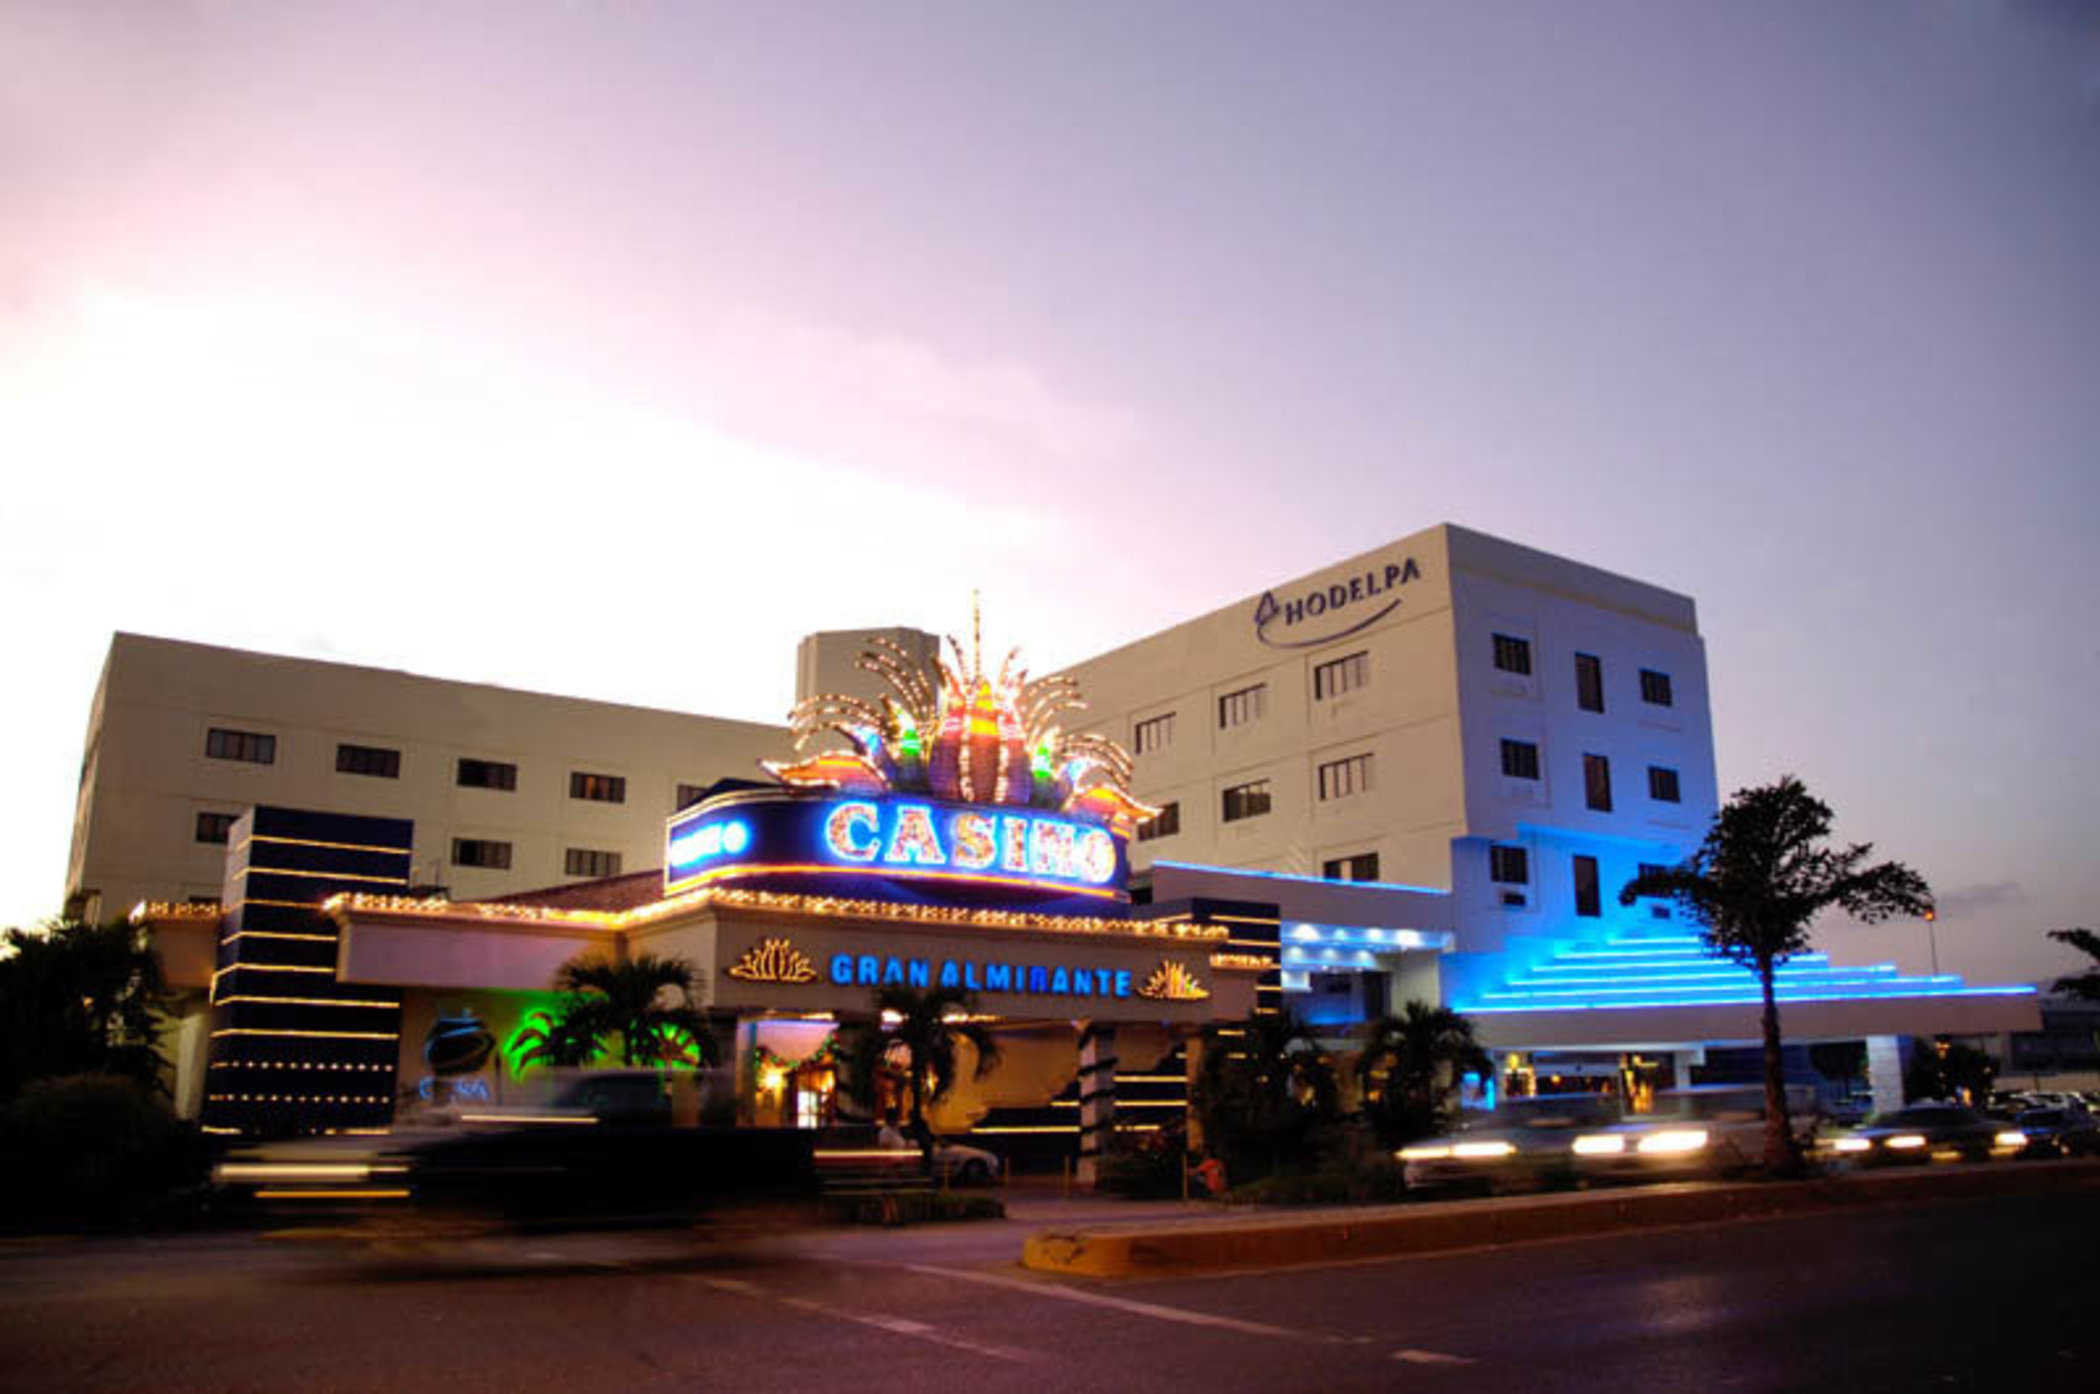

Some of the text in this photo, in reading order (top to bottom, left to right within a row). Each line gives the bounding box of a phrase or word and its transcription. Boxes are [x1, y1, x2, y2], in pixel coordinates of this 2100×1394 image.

[1285, 557, 1420, 626] HODELPA
[826, 802, 1116, 883] CASINO
[830, 953, 1133, 997] GRAN ALMIRANTE
